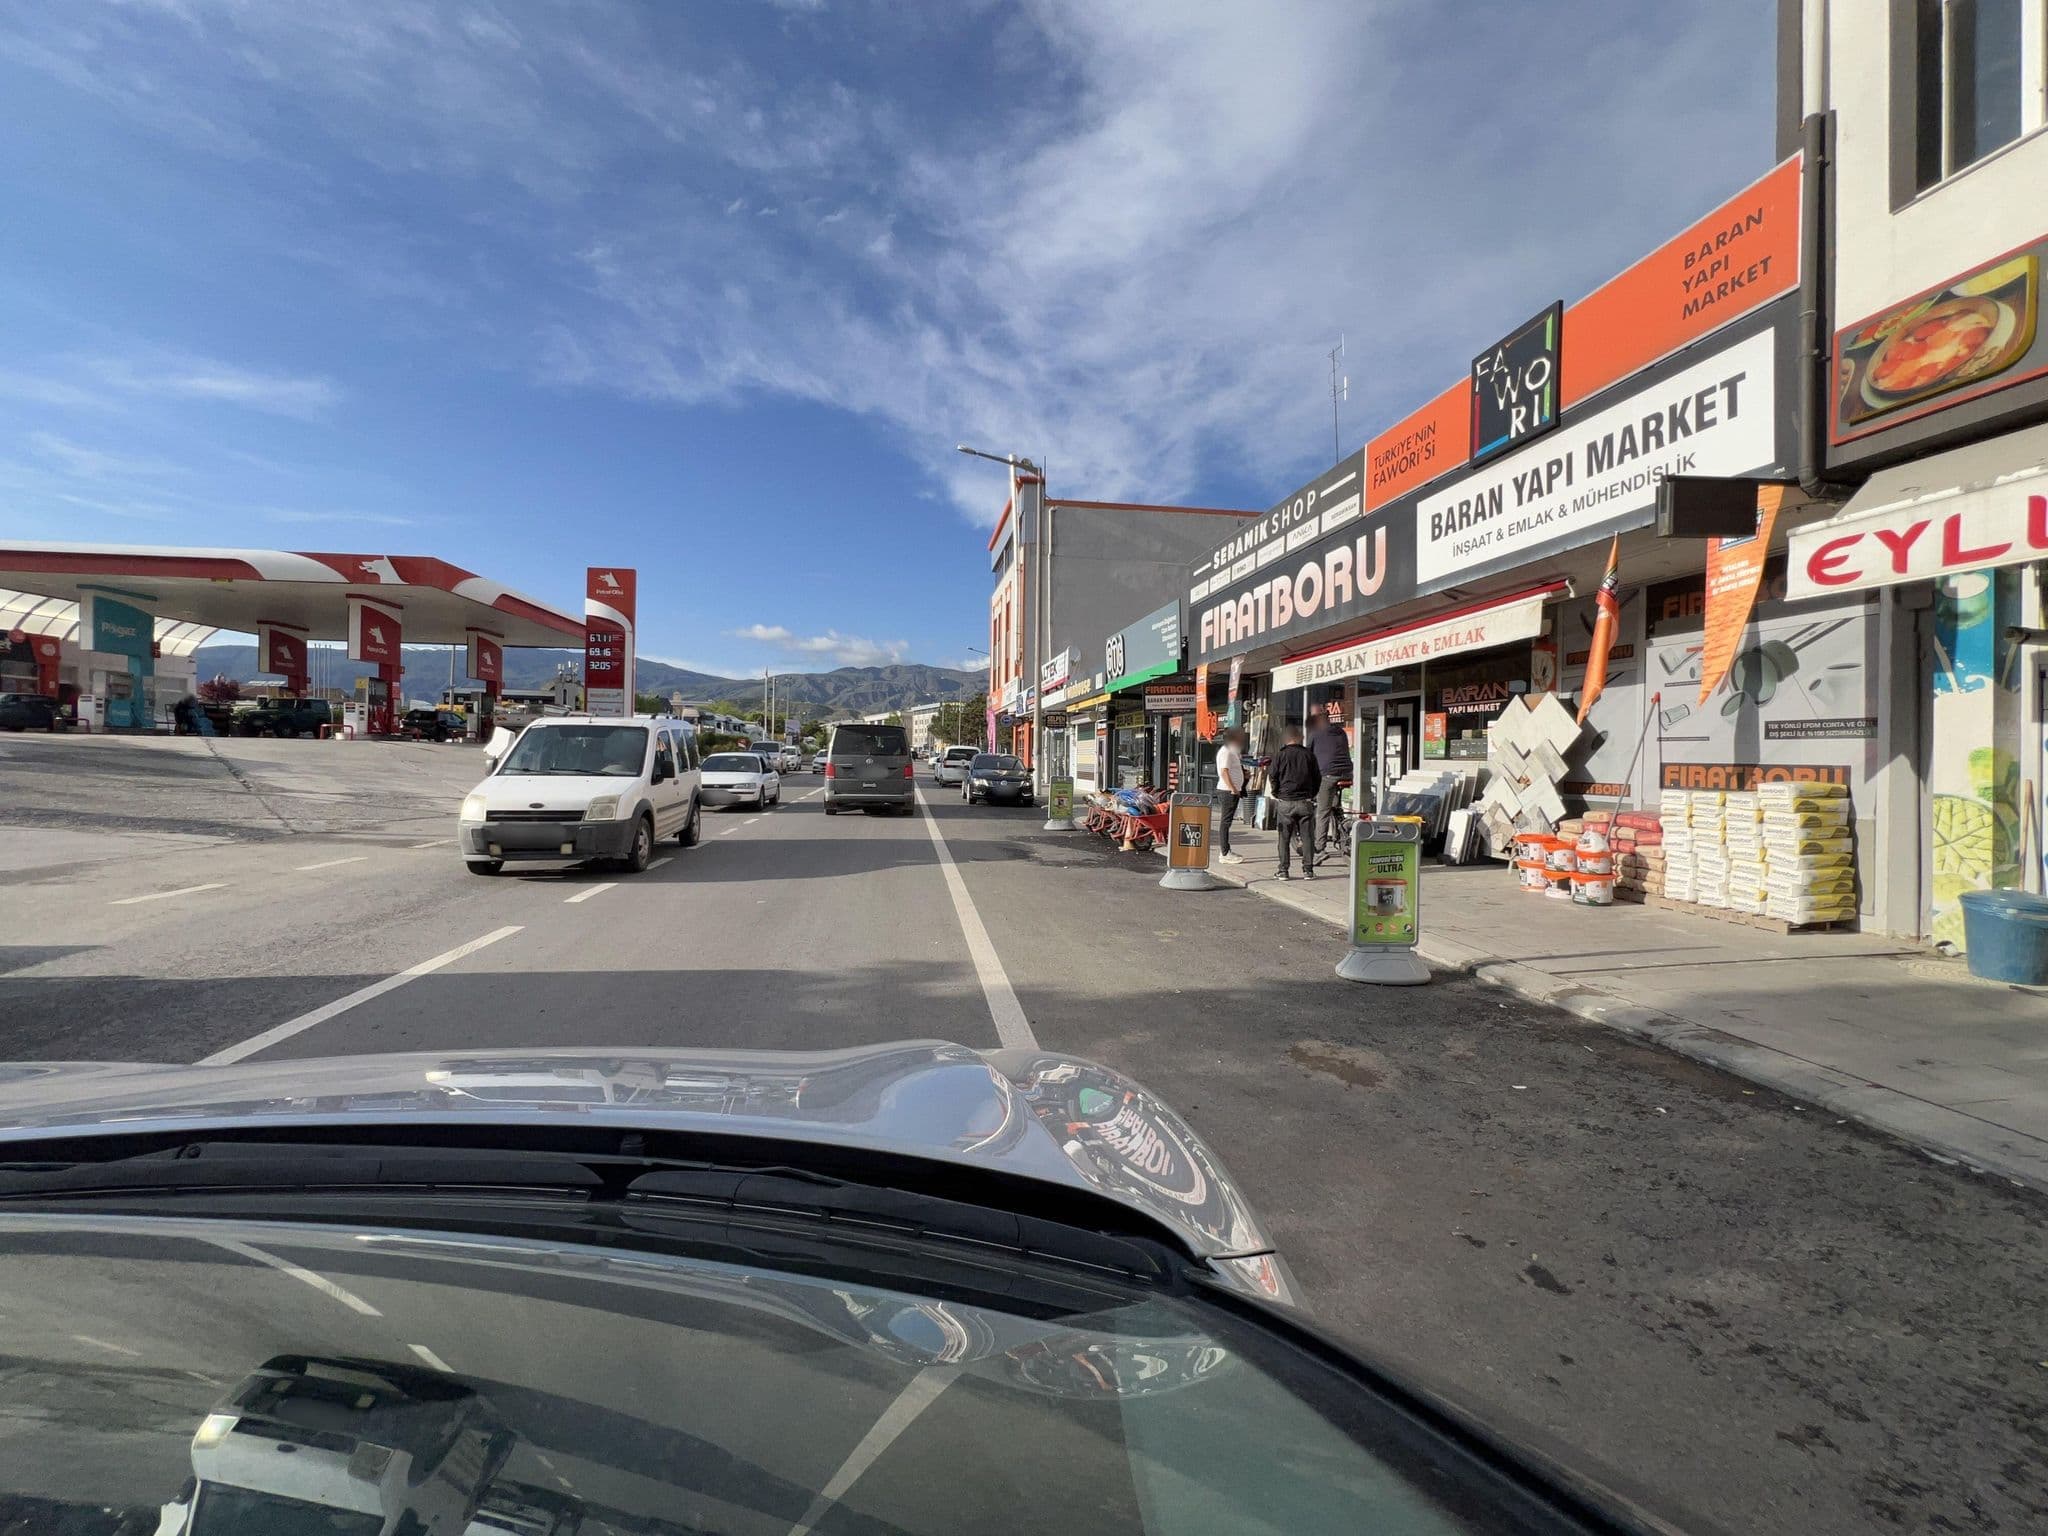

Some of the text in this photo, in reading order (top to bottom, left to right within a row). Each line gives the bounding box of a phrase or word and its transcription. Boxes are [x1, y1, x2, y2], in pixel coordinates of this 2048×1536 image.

[1684, 207, 1763, 270] BARAN
[1682, 254, 1729, 294] YAPI
[1682, 255, 1772, 320] MARKET
[1430, 371, 1746, 543] BARAN YAPI MARKET
[1271, 490, 1317, 534] SHOP
[1452, 531, 1493, 558] İNŞAAT
[1496, 529, 1505, 541] &
[1508, 508, 1554, 538] EMLAK
[1558, 503, 1568, 518] &
[1200, 525, 1387, 655] FIRATBORU
[1315, 651, 1369, 679] BARAN
[1421, 641, 1430, 655] &
[1433, 626, 1486, 652] EMLAK
[1442, 680, 1509, 703] BARAN
[1448, 703, 1501, 714] YAPI MARKET
[1377, 863, 1404, 873] ULTRA
